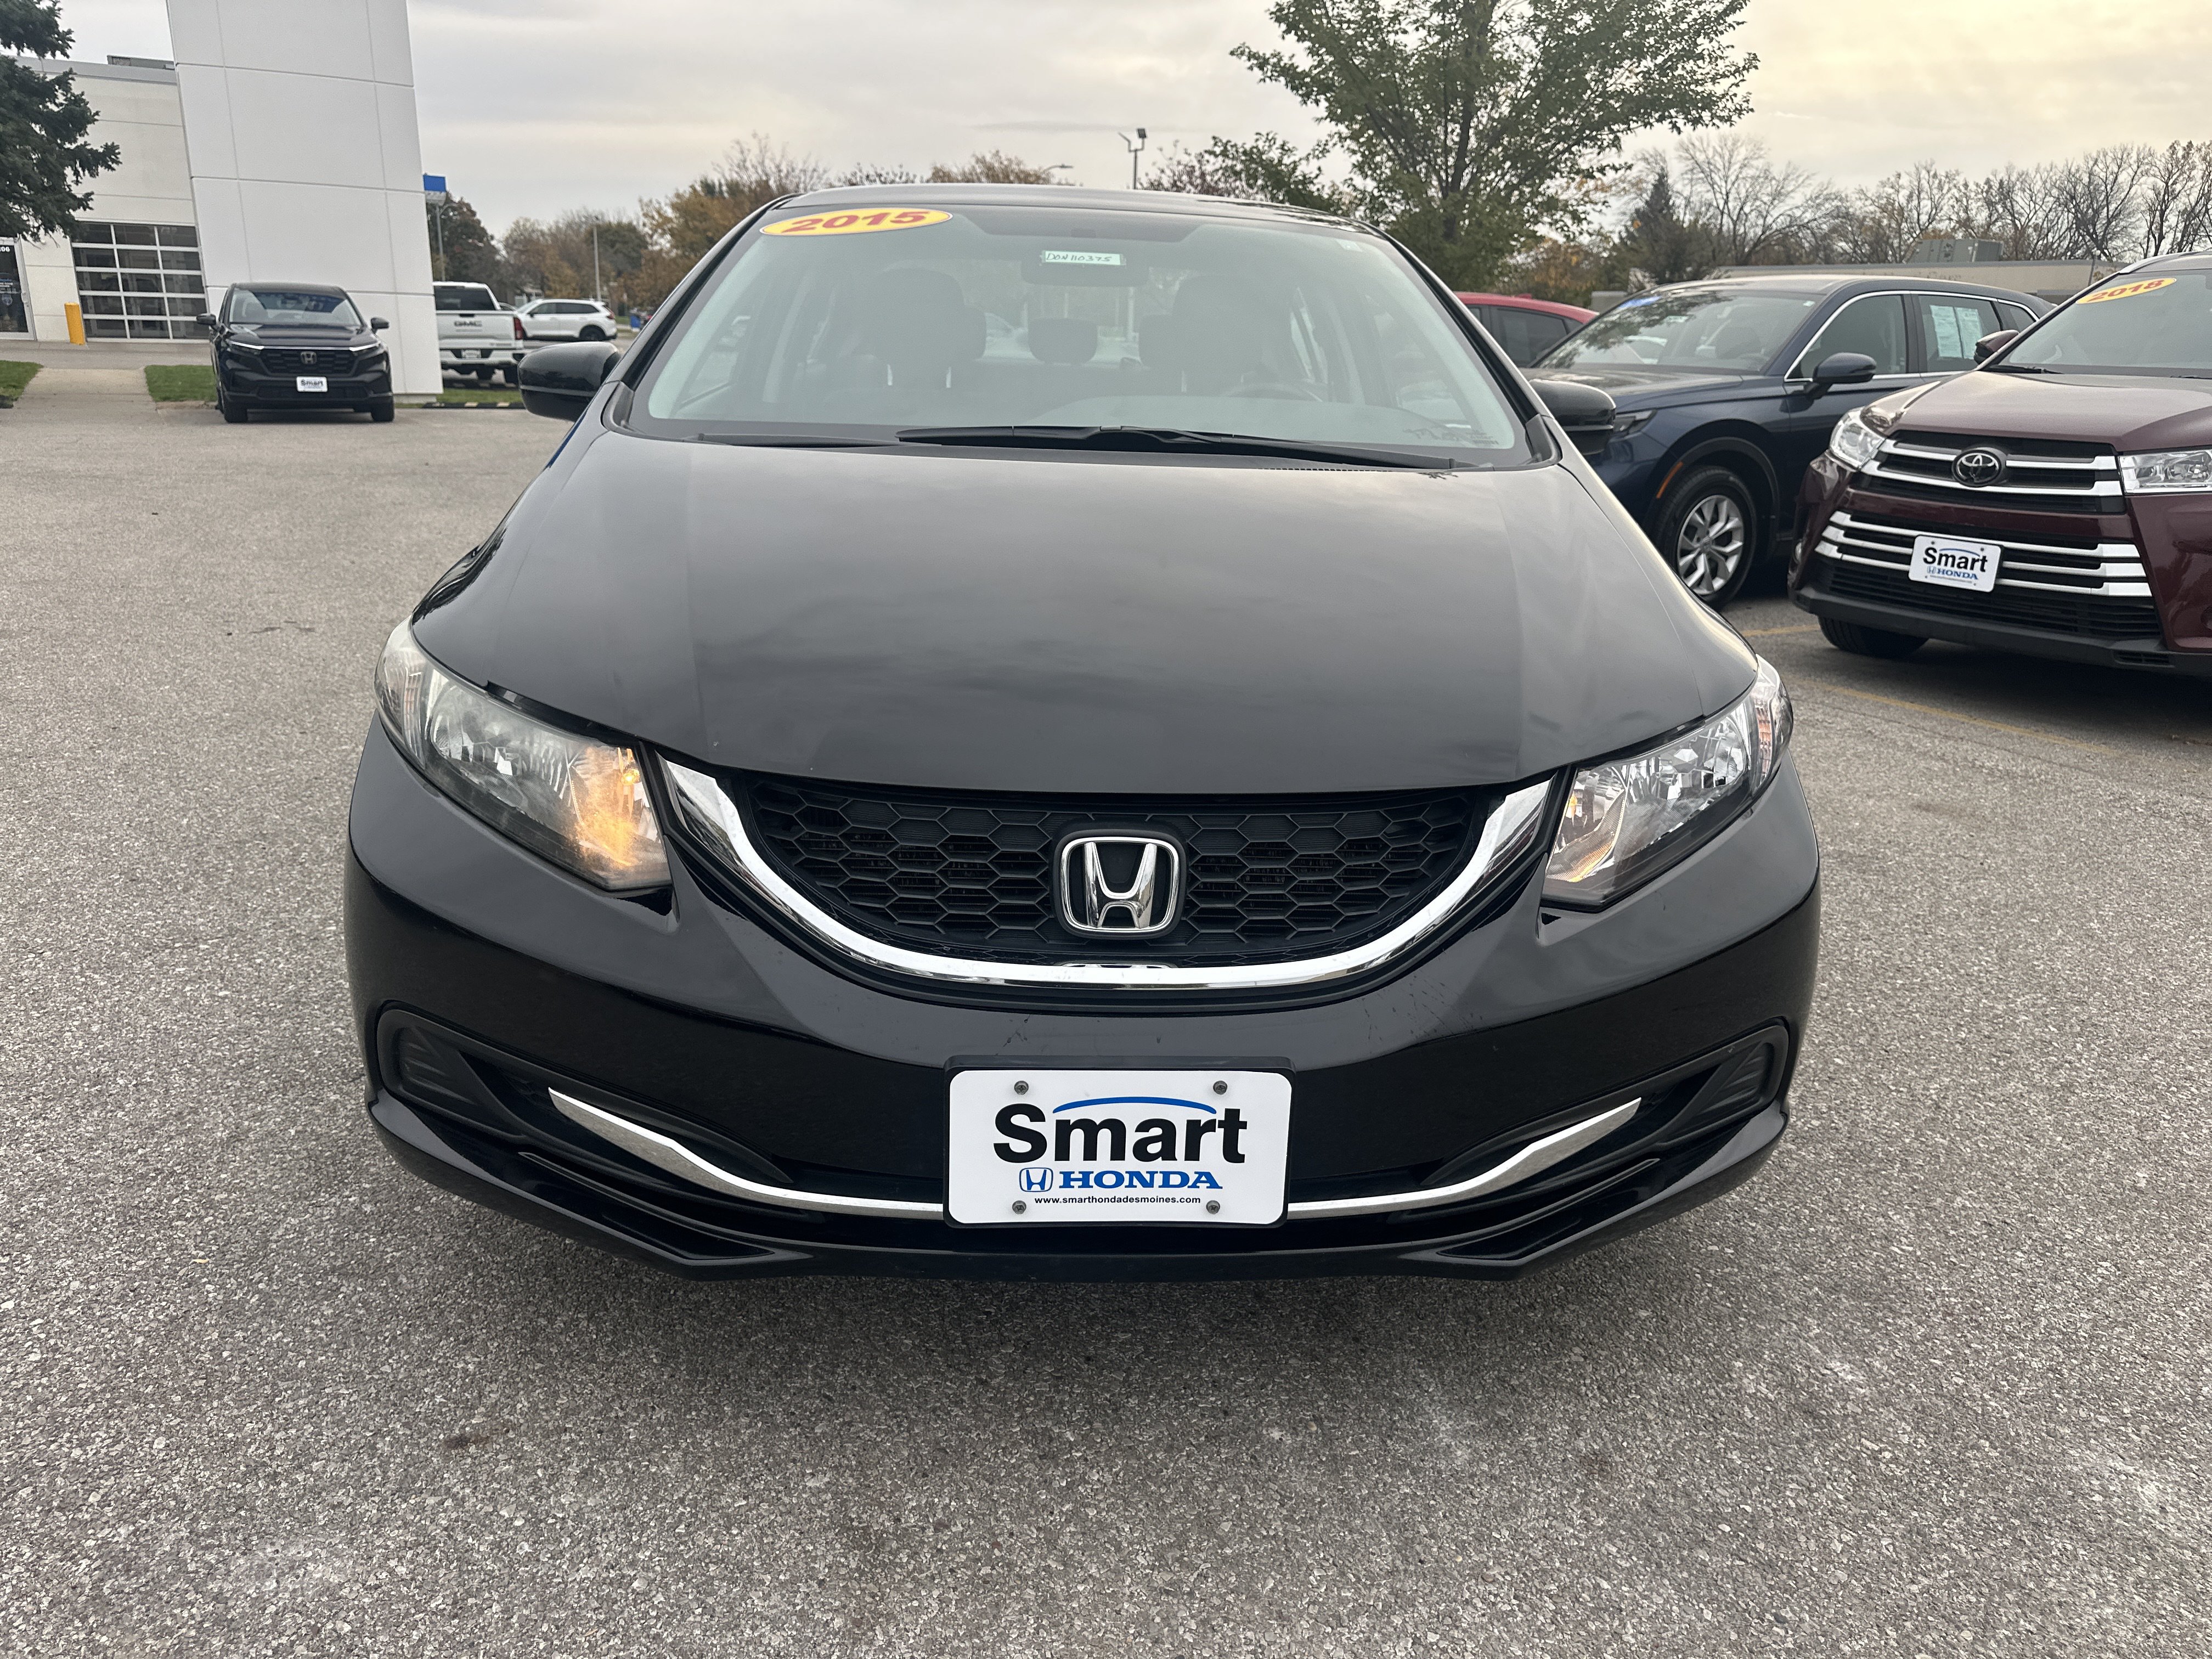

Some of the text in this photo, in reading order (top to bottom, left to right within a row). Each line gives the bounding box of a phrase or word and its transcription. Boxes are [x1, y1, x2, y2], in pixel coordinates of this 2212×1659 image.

[781, 211, 931, 233] 2015
[2087, 280, 2165, 302] 2018
[1923, 547, 1988, 572] Smart
[1937, 568, 1978, 580] HONDA
[993, 1103, 1247, 1163] Smart
[1059, 1171, 1223, 1189] HONDA
[1034, 1195, 1201, 1204] www.smarthondadesmoines.com
